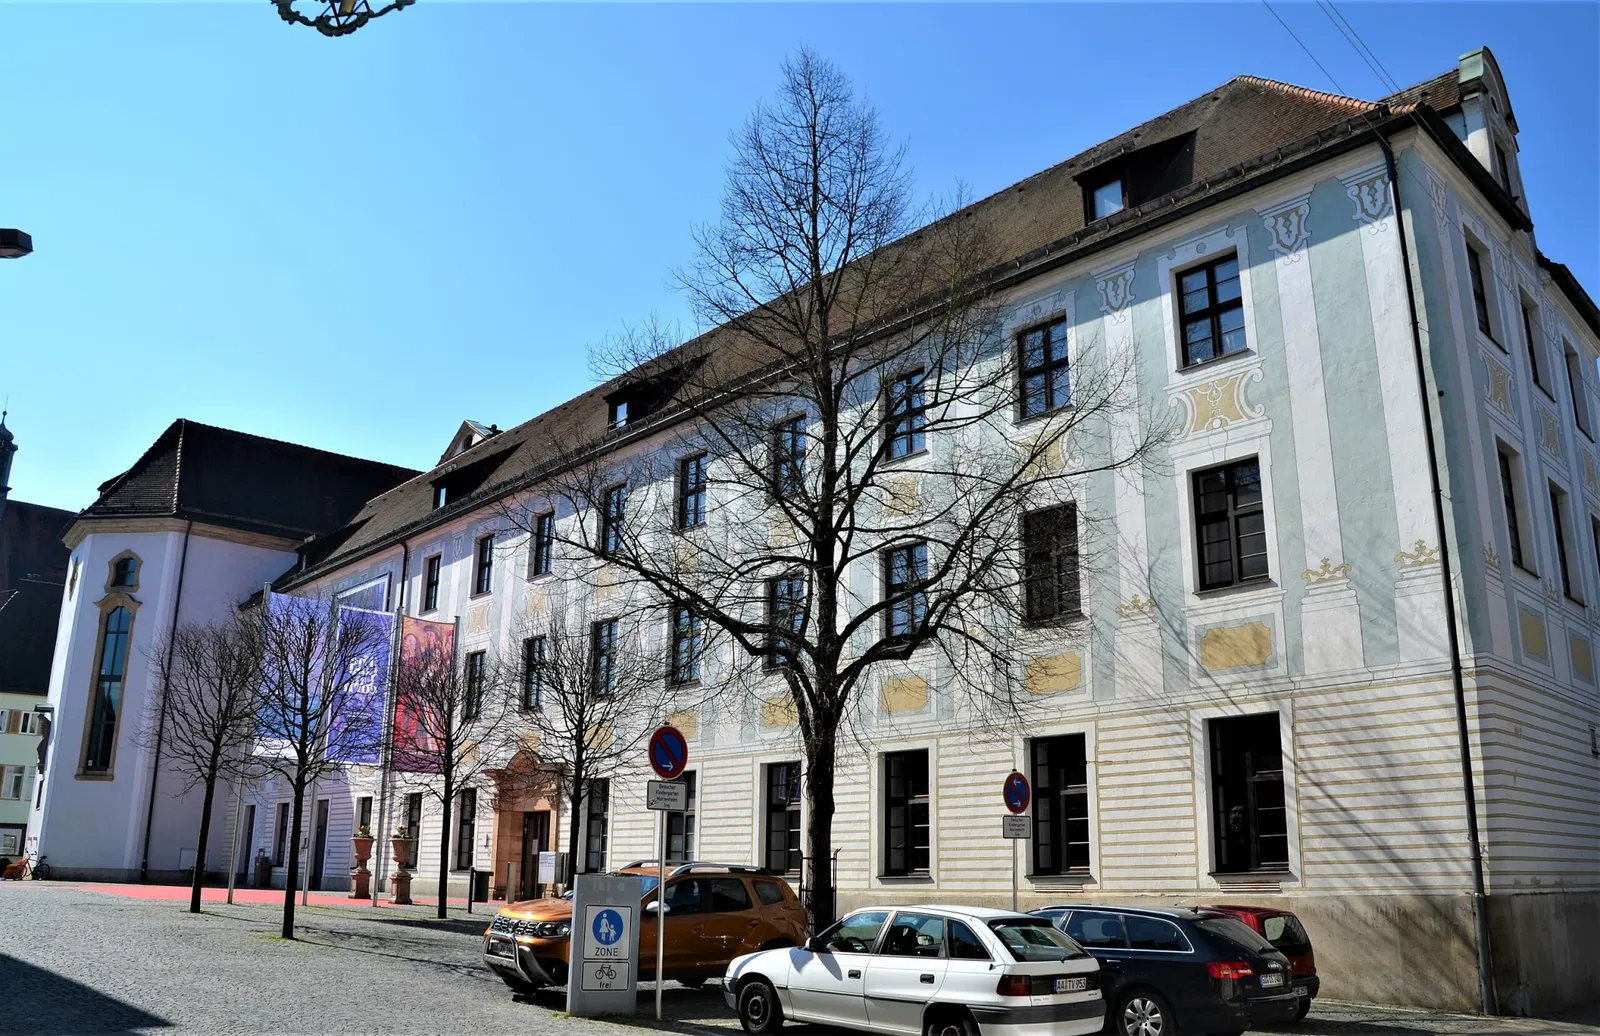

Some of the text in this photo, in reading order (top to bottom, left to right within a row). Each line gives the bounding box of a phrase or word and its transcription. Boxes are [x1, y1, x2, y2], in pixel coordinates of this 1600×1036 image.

[594, 947, 619, 957] ZONE
[599, 981, 612, 989] frei
[1057, 978, 1086, 990] AA TV 953
